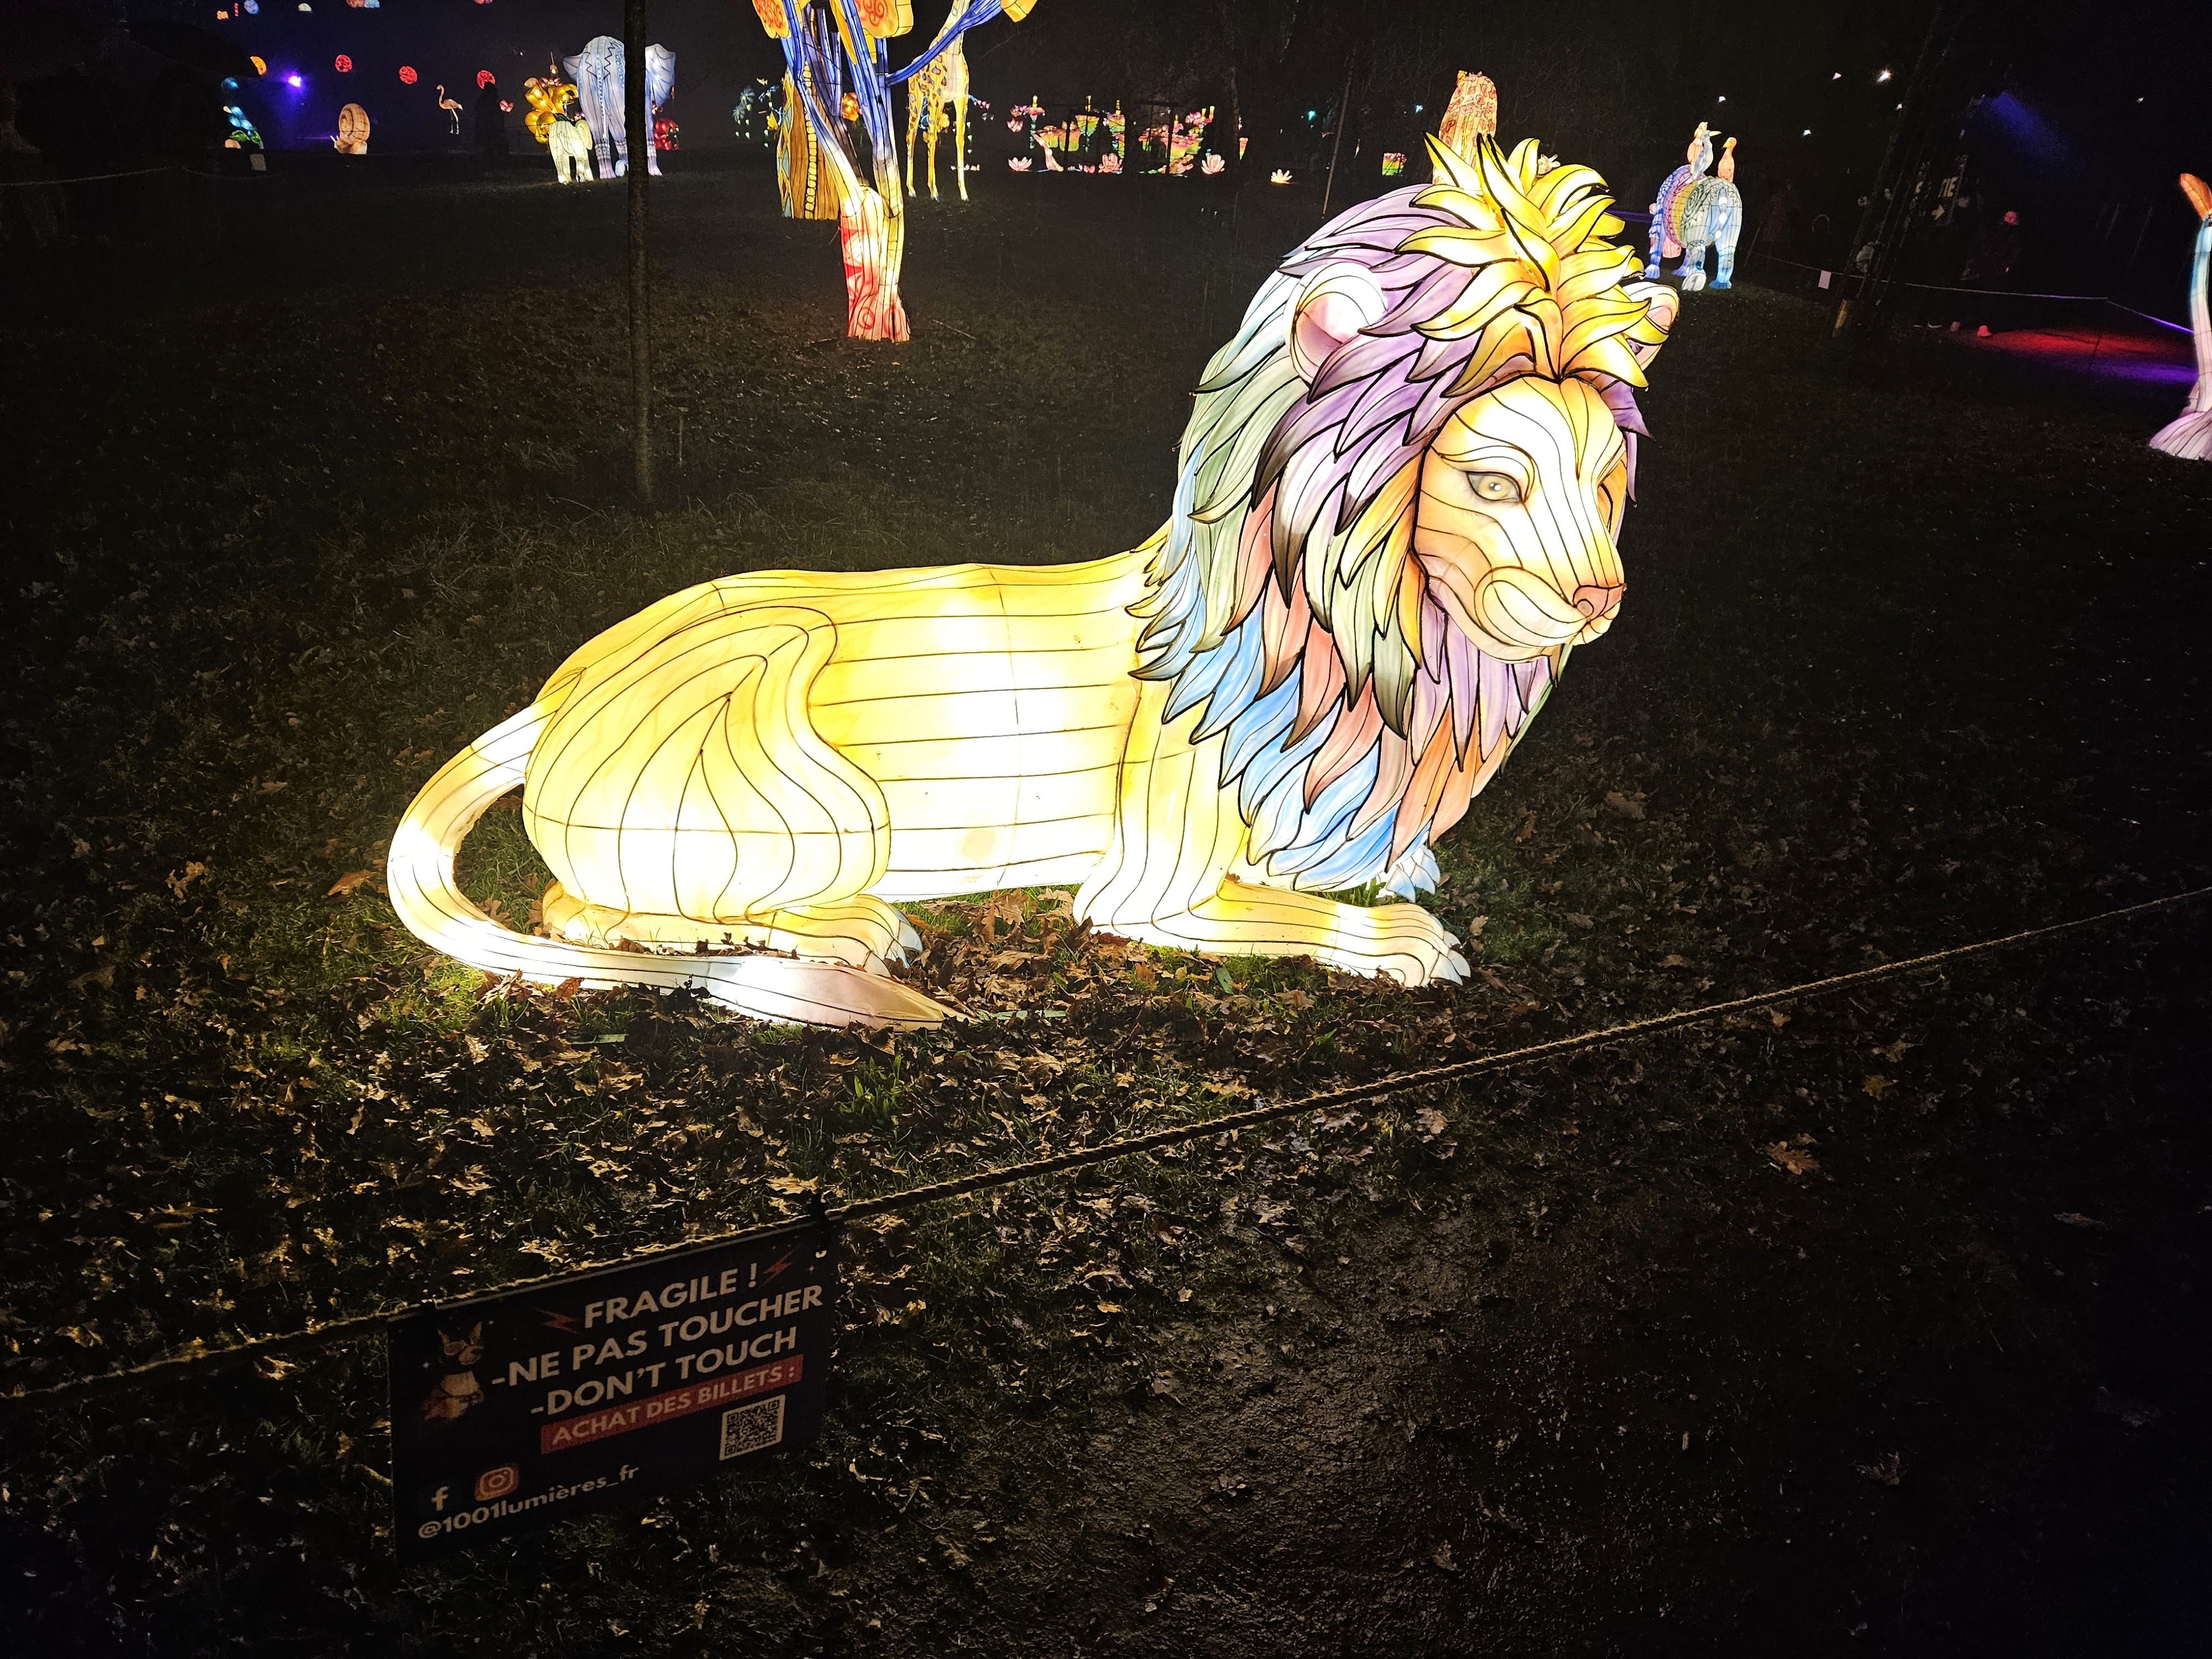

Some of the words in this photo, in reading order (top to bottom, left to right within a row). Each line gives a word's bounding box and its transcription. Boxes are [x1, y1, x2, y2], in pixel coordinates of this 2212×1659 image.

[585, 1268, 738, 1328] FRAGILE
[748, 1262, 757, 1287] !
[491, 1351, 560, 1386] -NE
[572, 1330, 648, 1371] PAS
[658, 1285, 823, 1347] TOUCHER
[675, 1326, 796, 1379] TOUCH
[552, 1406, 640, 1445] ACHAT
[646, 1392, 691, 1419] DES
[697, 1366, 782, 1404] BILLETS
[418, 1464, 639, 1539] @1001lumières_fr
